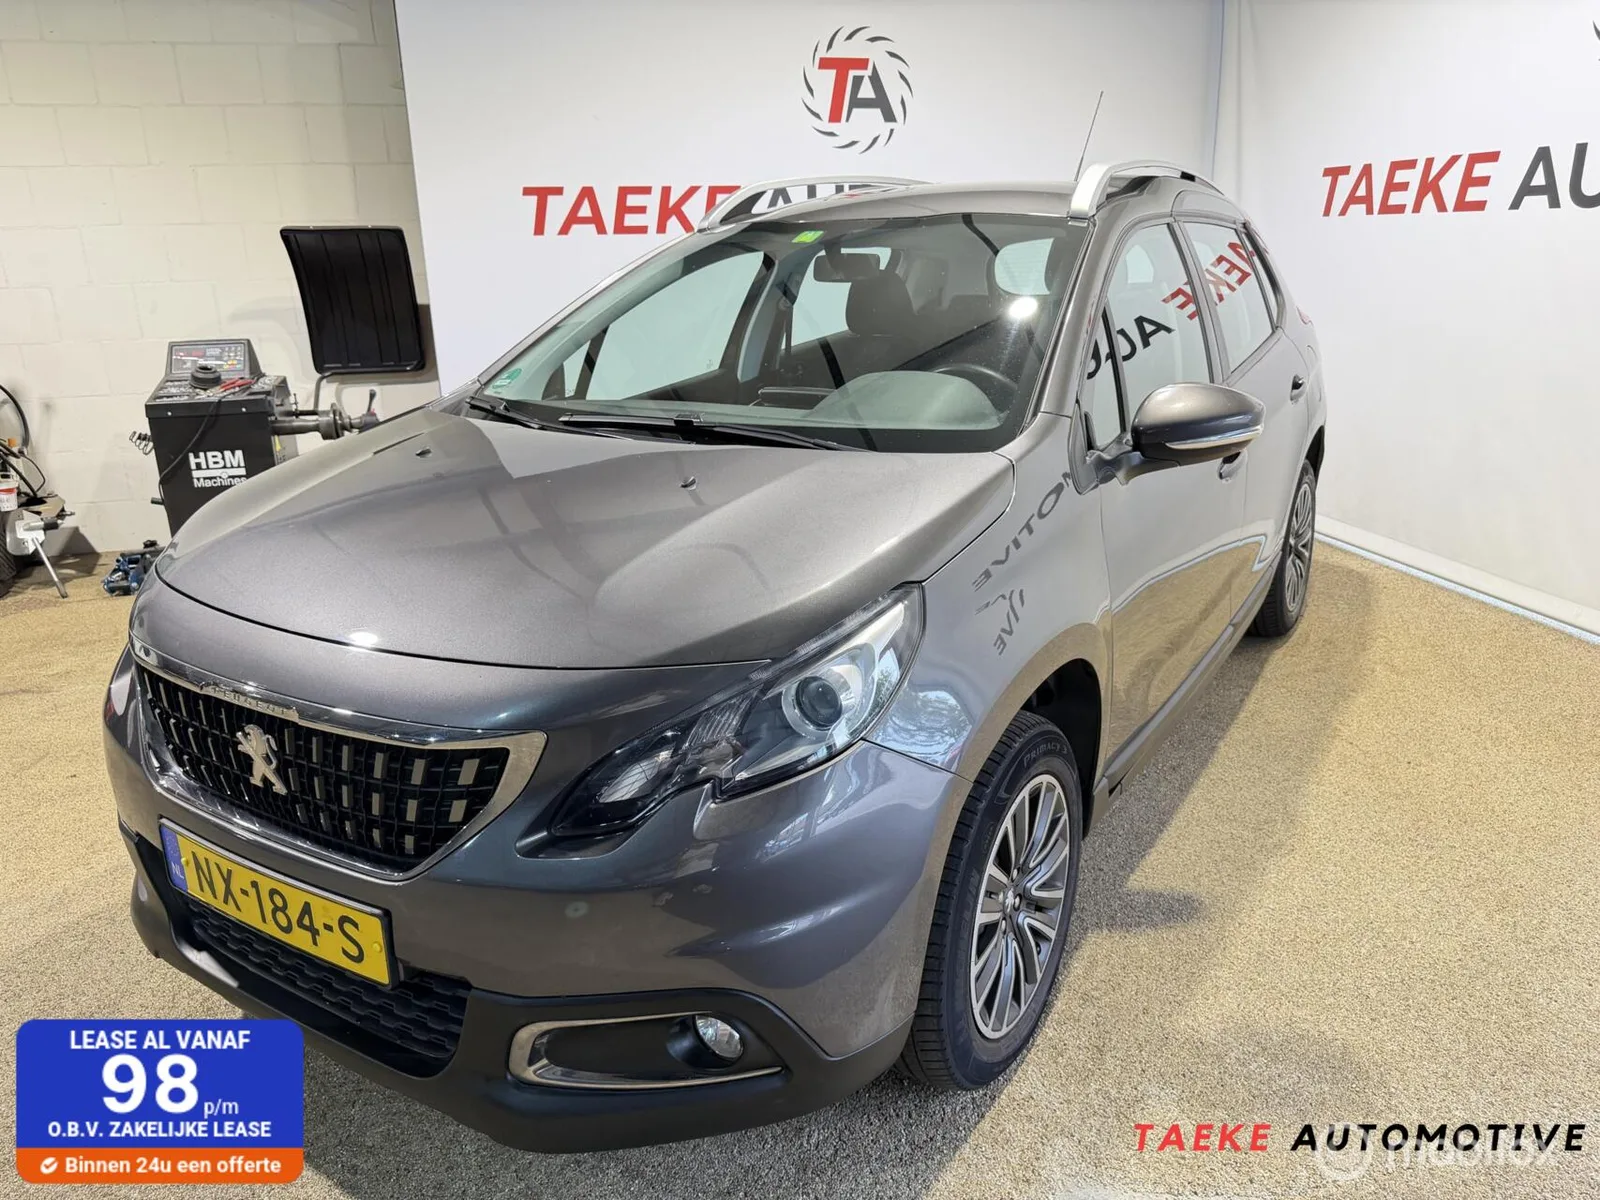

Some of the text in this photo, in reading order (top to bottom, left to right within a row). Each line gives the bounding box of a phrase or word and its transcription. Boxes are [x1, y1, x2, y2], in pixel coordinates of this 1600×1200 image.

[817, 56, 897, 124] TA
[1321, 151, 1501, 217] TAEKE
[188, 450, 245, 470] HBM
[171, 863, 184, 879] NL
[191, 850, 365, 964] NX-184-S
